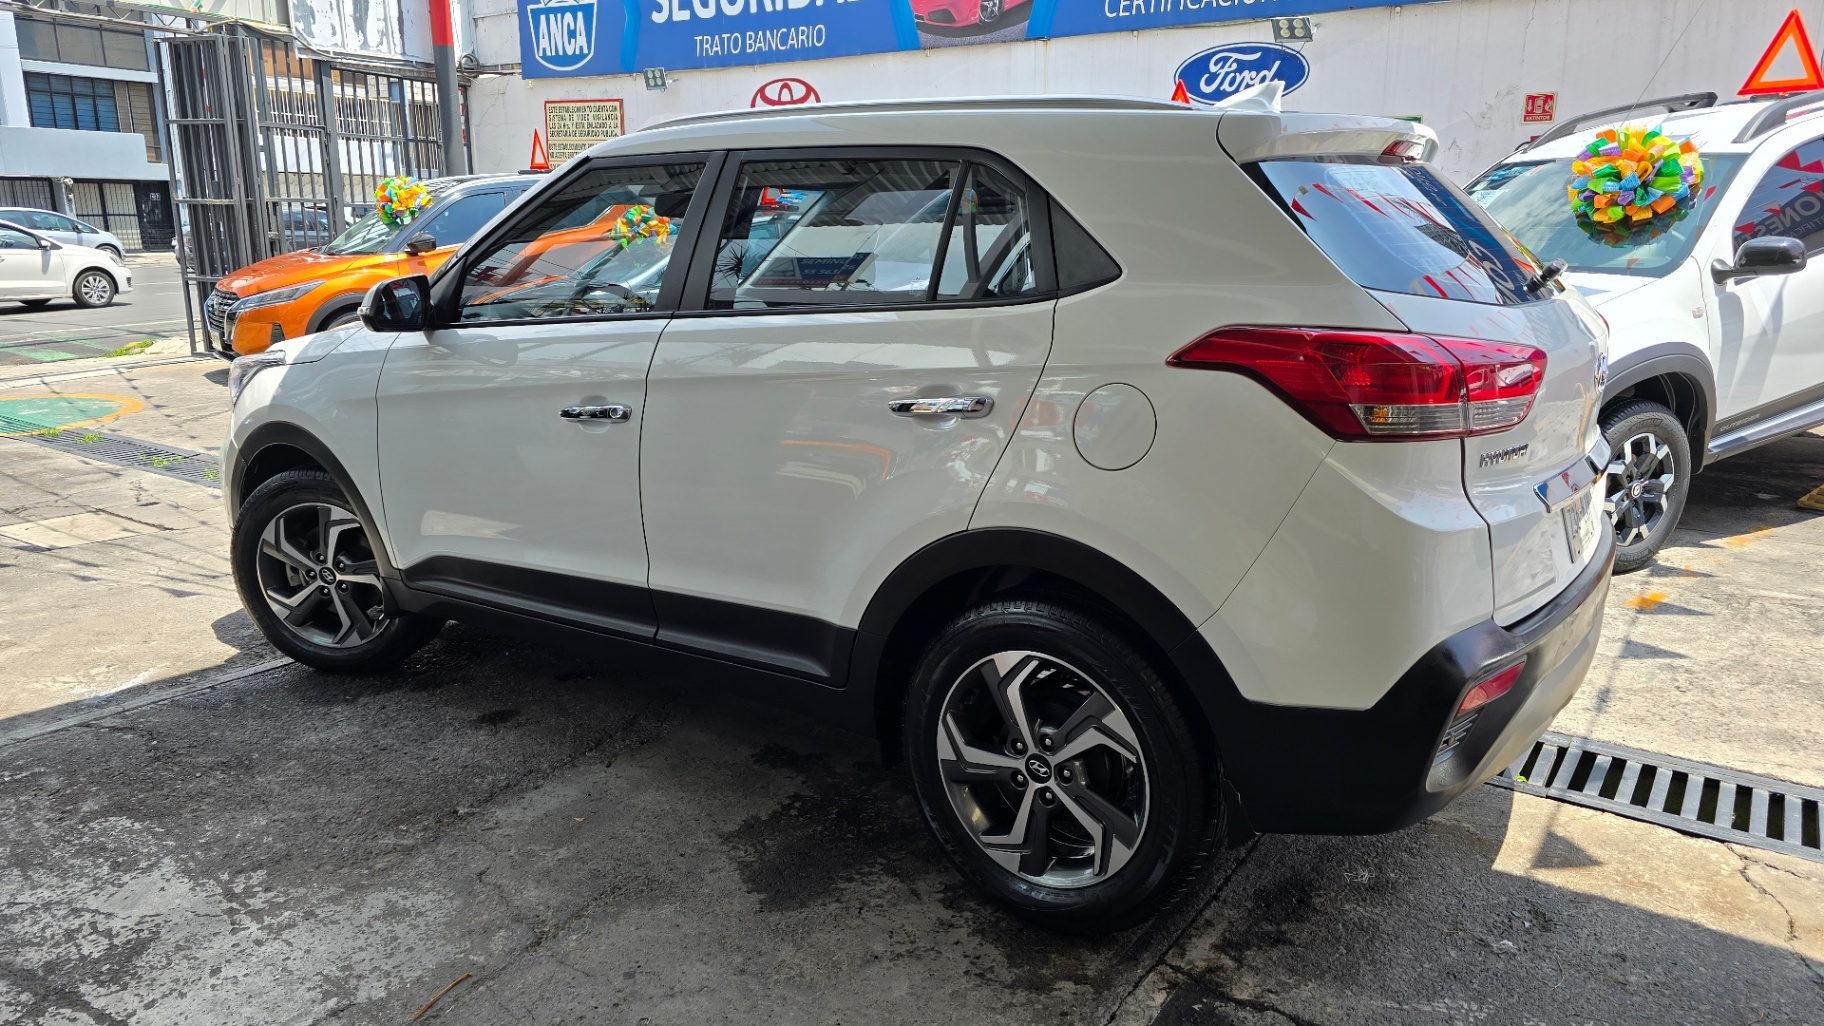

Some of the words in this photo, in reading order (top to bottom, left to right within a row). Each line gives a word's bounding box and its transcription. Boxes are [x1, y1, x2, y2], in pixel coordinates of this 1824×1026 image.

[538, 11, 588, 56] ANCA
[694, 33, 741, 57] TRATO
[746, 24, 826, 53] BANCARIO
[1199, 51, 1282, 92] Ford
